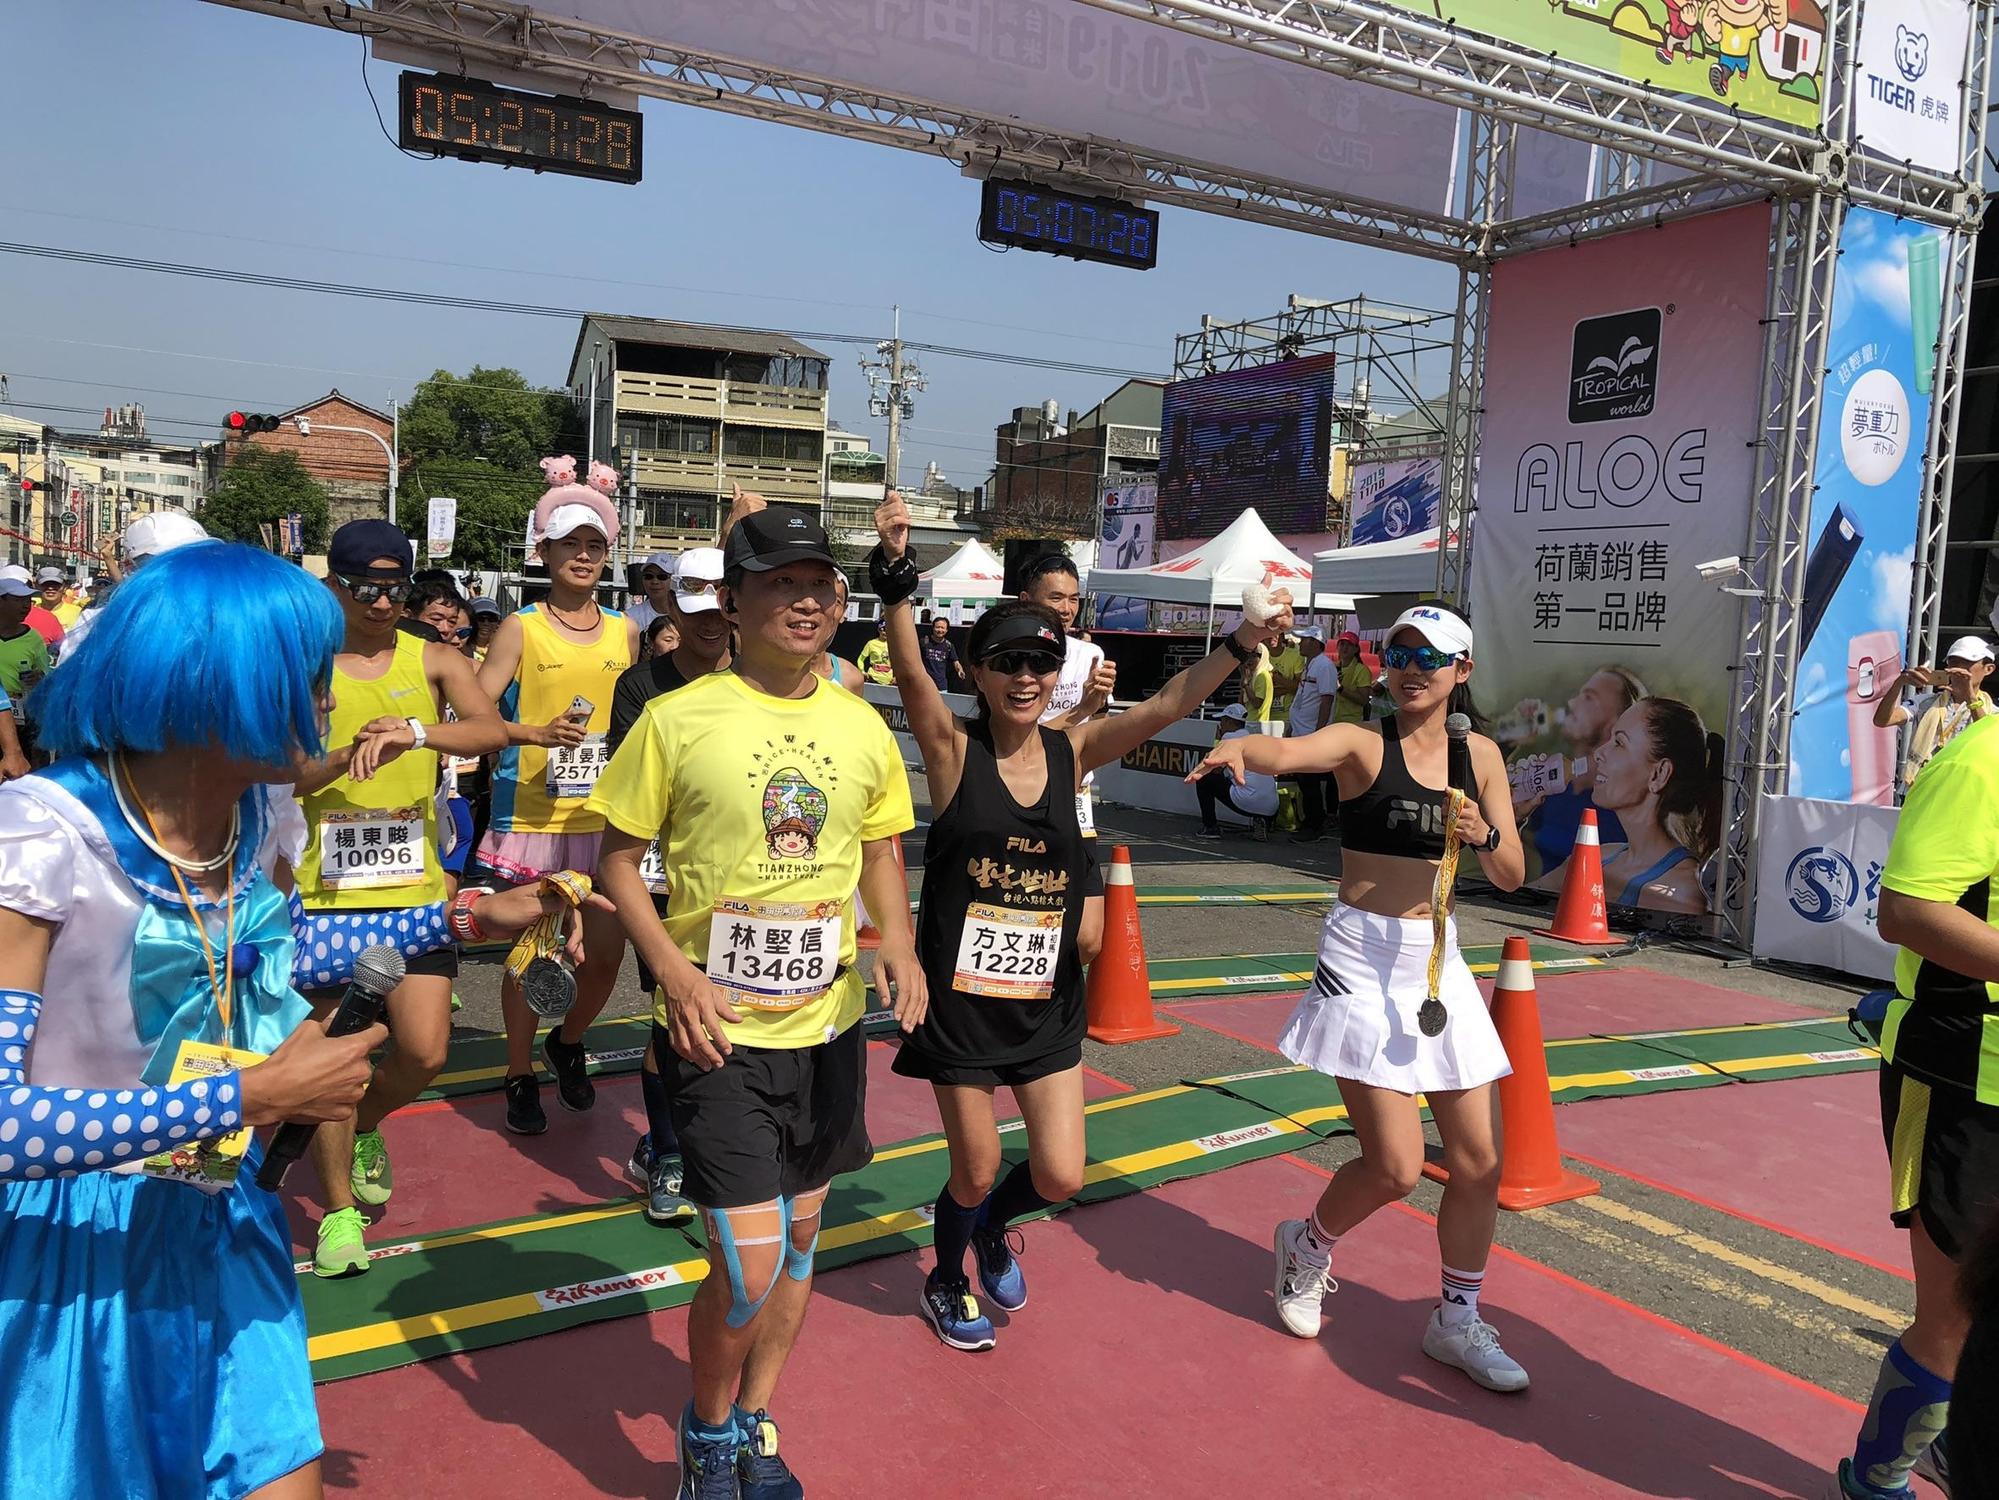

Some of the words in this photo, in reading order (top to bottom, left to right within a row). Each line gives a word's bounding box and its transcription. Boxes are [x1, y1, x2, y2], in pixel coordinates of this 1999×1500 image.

[1867, 74, 1915, 114] TIGER
[1921, 96, 1949, 124] 虎牌
[415, 86, 632, 169] 05:27:28
[997, 190, 1149, 258] 05:07:28
[1575, 372, 1650, 399] TROPICAL
[1610, 396, 1652, 417] world
[1873, 441, 1896, 456] ボトル
[1361, 467, 1385, 490] 2019
[1514, 429, 1706, 512] ALOE
[1360, 478, 1385, 500] 11/10
[1534, 540, 1669, 582] 荷蘭銷售
[1411, 609, 1440, 621] FILA
[1533, 591, 1667, 632] 第一品牌
[1046, 699, 1078, 711] OACH
[1123, 744, 1202, 773] CHAIRM
[554, 765, 606, 780] 2571
[1386, 800, 1447, 834] FIL
[335, 826, 409, 848] 楊東畯
[1006, 836, 1048, 853] FILA
[332, 847, 412, 868] 10096
[757, 863, 825, 873] TIANZHONG
[723, 901, 750, 912] FILA
[974, 907, 996, 918] FILA
[729, 922, 823, 955] 林堅信
[973, 927, 1045, 954] 方文琳
[722, 950, 824, 982] 13468
[970, 950, 1048, 976] 12228
[930, 1295, 946, 1313] FILA
